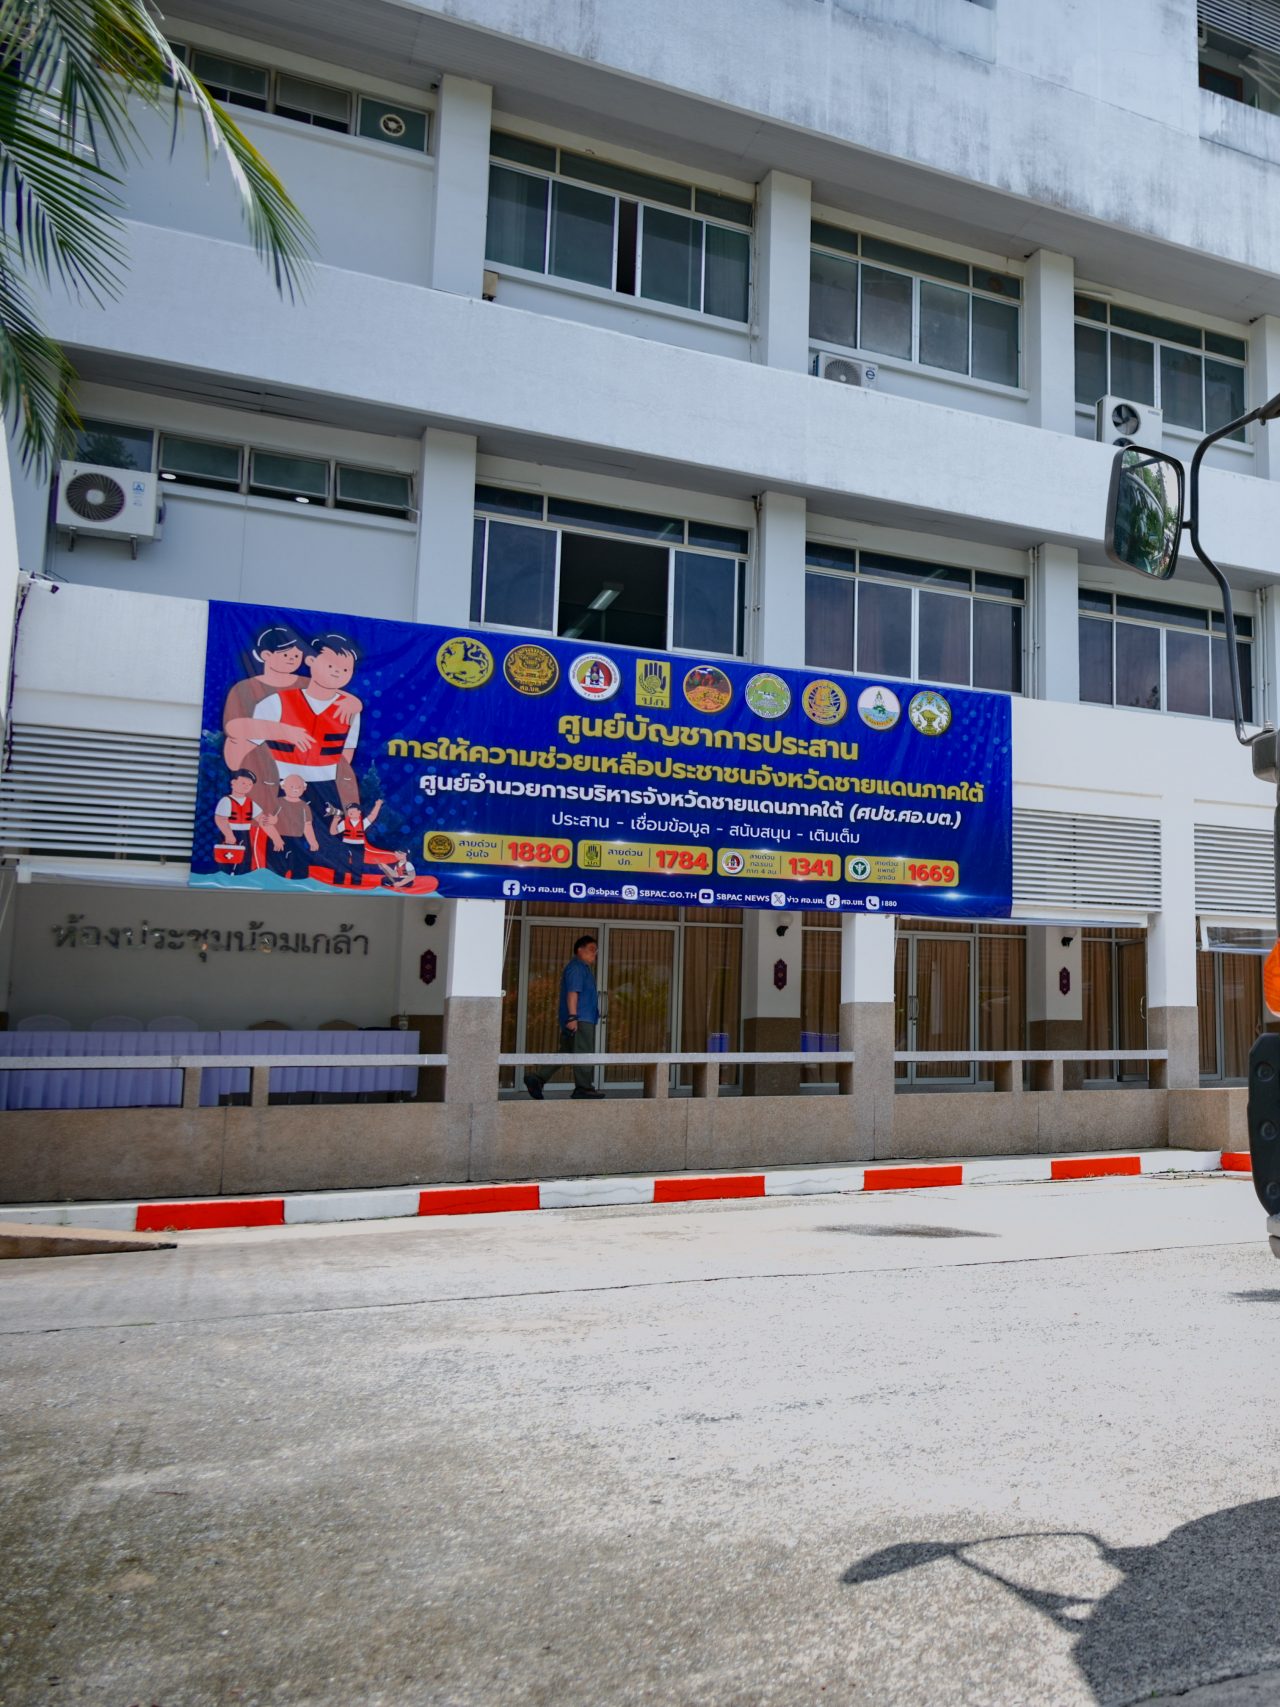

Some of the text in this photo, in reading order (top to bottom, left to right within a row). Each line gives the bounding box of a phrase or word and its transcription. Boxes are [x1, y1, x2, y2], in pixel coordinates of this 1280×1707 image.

[557, 711, 860, 761] ศูนย์บัญชาการประสาน
[387, 736, 985, 803] การให้ความช่วยเหลือประชาชนจังหวัดชายแดนภาคใต้
[419, 772, 962, 830] ศูนย์อำนวยการบริหารจังหวัดชายแดนภาคใต้ (ศปช.ศอ.บต.)
[551, 811, 610, 829] ประสาน
[630, 812, 710, 838] เชื่อมข้อมูล
[729, 823, 791, 844] สนับสนุน
[809, 827, 860, 844] เติมเต็ม
[458, 839, 497, 849] สายด่วน
[465, 849, 489, 859] อุ่นใจ
[507, 841, 571, 863] 1880
[607, 848, 643, 857] สายด่วน
[655, 850, 710, 871] 1784
[788, 857, 834, 877] 1341
[907, 863, 955, 883] 1669
[521, 883, 536, 893] ข่าว
[586, 887, 620, 897] @sbpac
[639, 889, 698, 900] SBPAC.GO.TH
[716, 892, 770, 903] SBPAC NEWS
